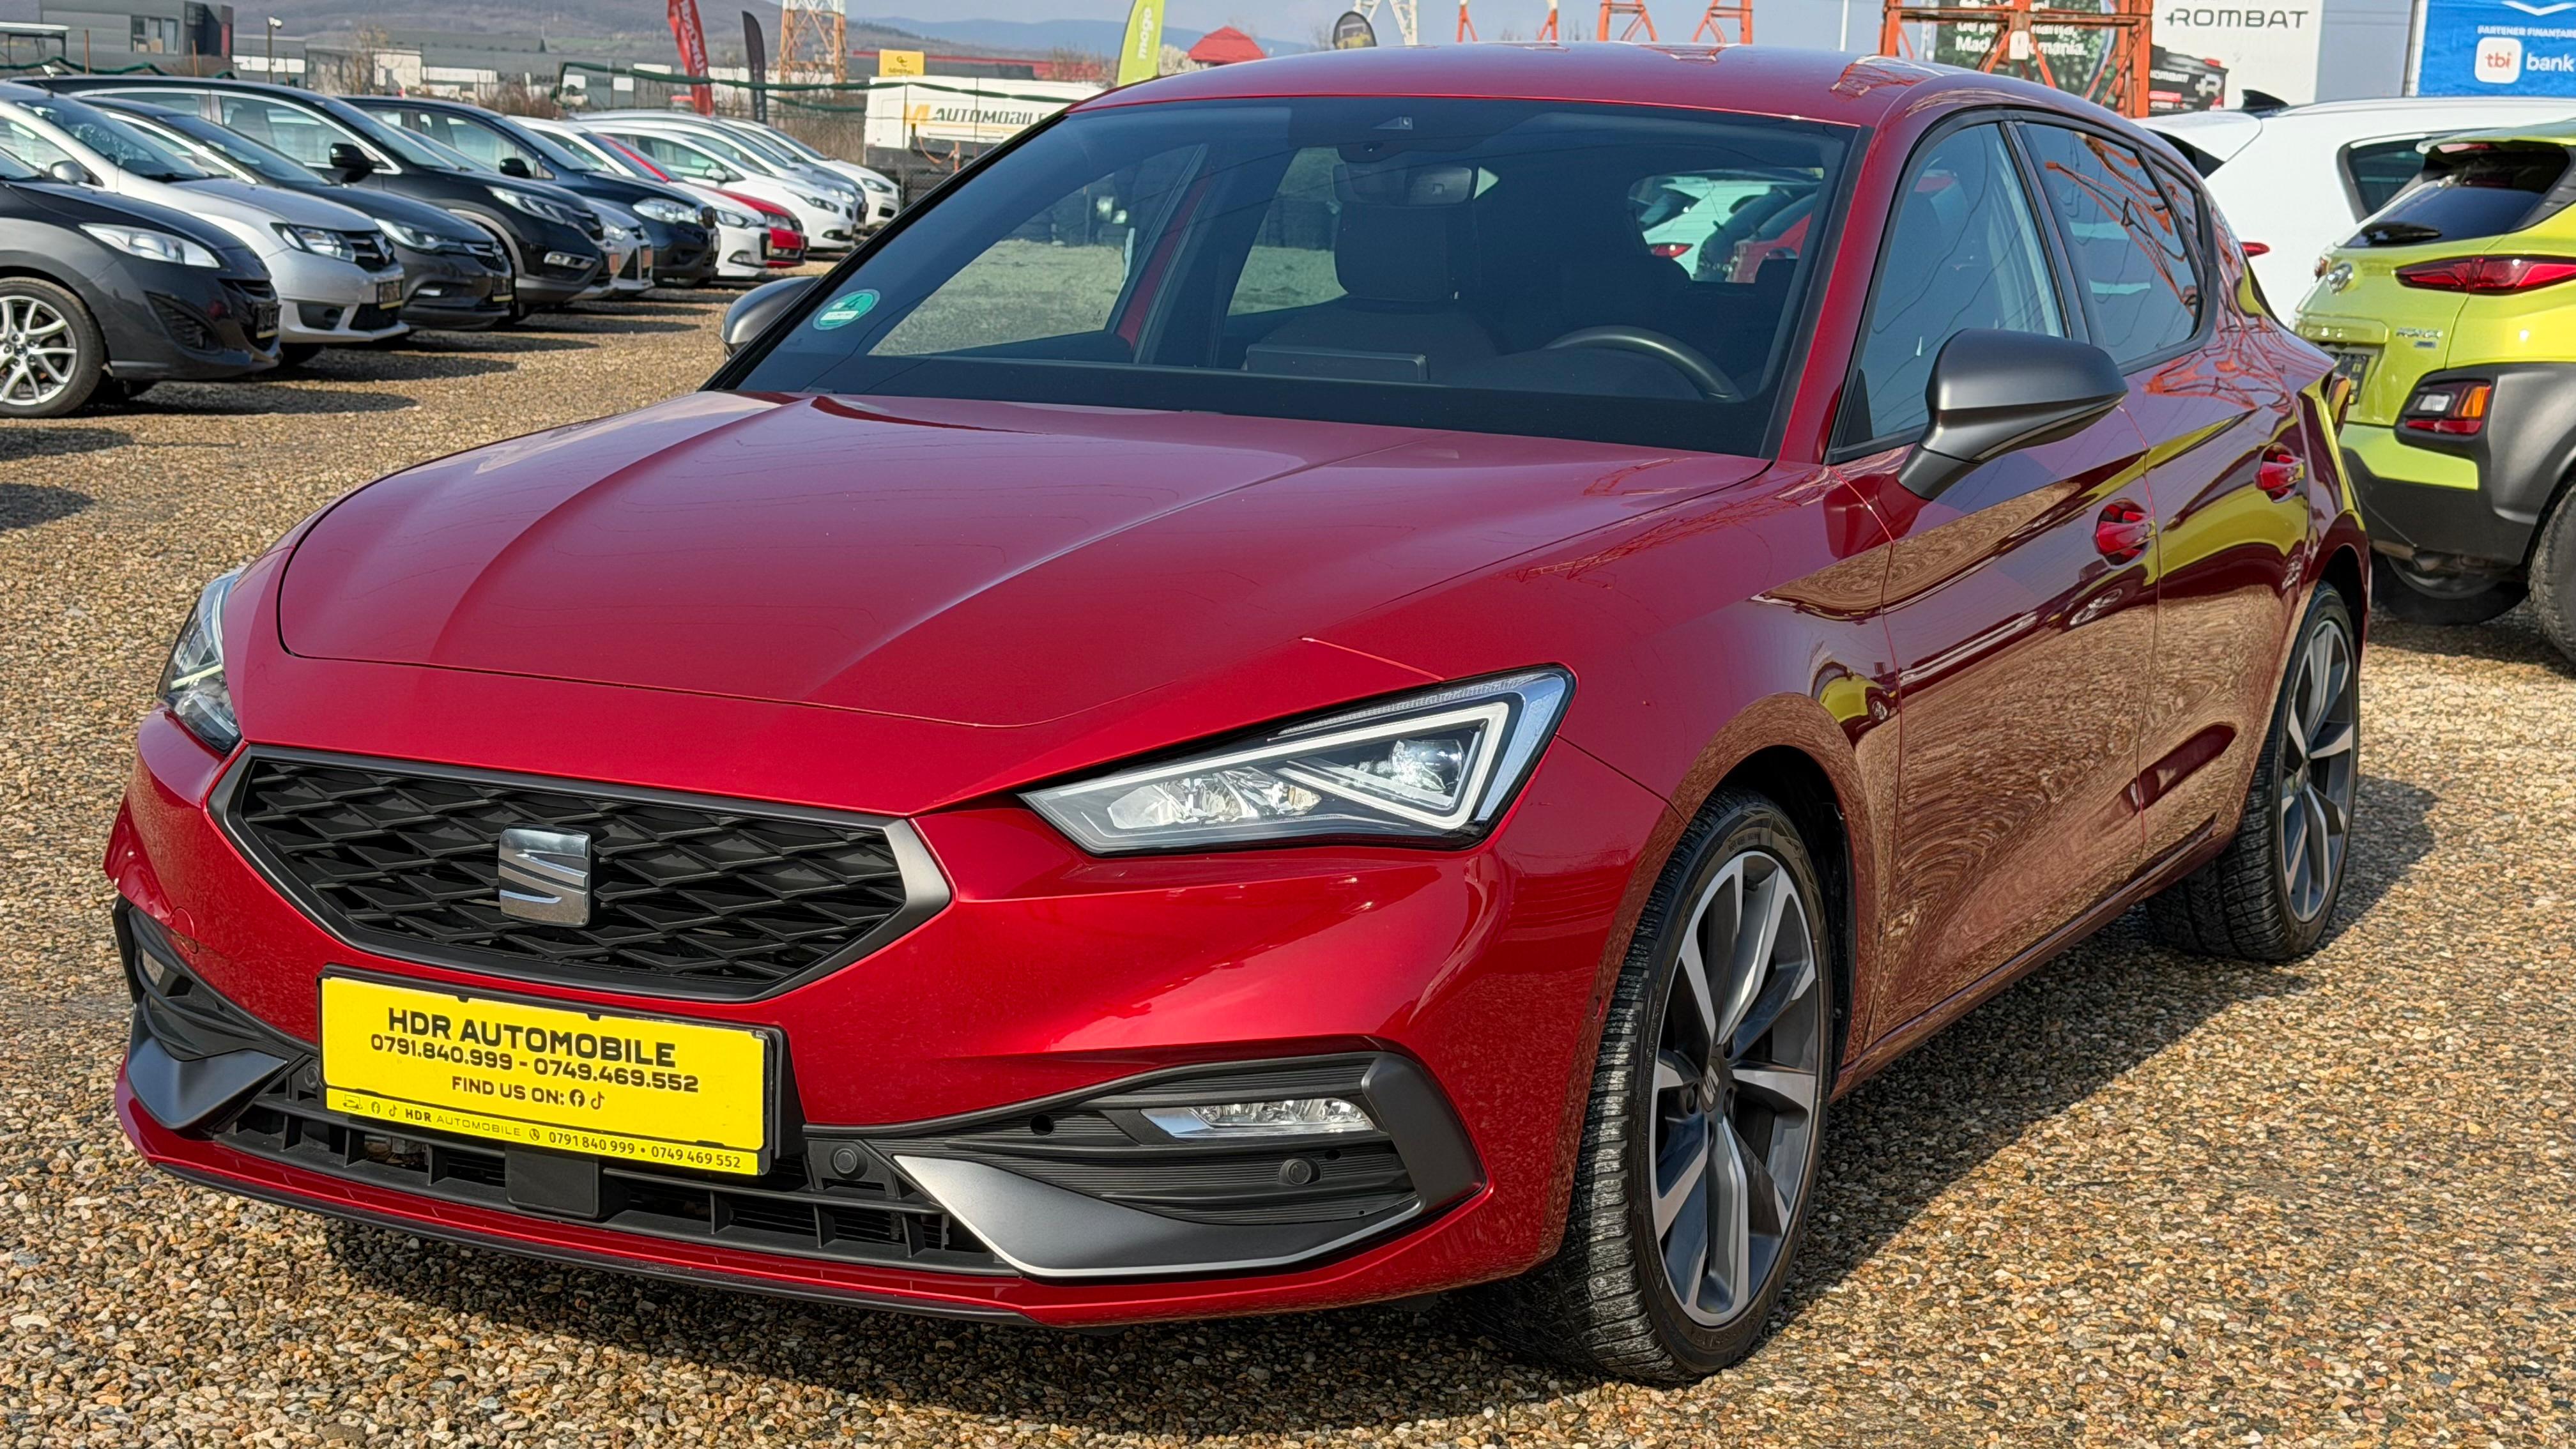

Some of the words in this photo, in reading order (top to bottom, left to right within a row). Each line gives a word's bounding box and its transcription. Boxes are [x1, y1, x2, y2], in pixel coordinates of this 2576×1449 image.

[2165, 8, 2309, 28] ROMBAT
[2477, 25, 2526, 36] PARTENER
[2485, 51, 2511, 69] tbi
[2526, 52, 2575, 72] bank
[388, 1007, 451, 1040] HDR
[459, 1018, 676, 1068] AUTOMOBILE
[371, 1034, 512, 1070] 0791.840.999
[533, 1057, 698, 1092] 0749.469.552
[452, 1076, 494, 1096] FIND
[500, 1083, 526, 1100] US
[531, 1088, 564, 1105] ON:
[405, 1108, 431, 1123] HDR
[436, 1115, 521, 1137] AUTOMOBILE
[549, 1131, 578, 1146] 0791
[582, 1137, 606, 1150] 840
[610, 1140, 634, 1154] 999
[652, 1146, 683, 1161] 0749
[687, 1151, 712, 1165] 469
[716, 1154, 741, 1169] 552
